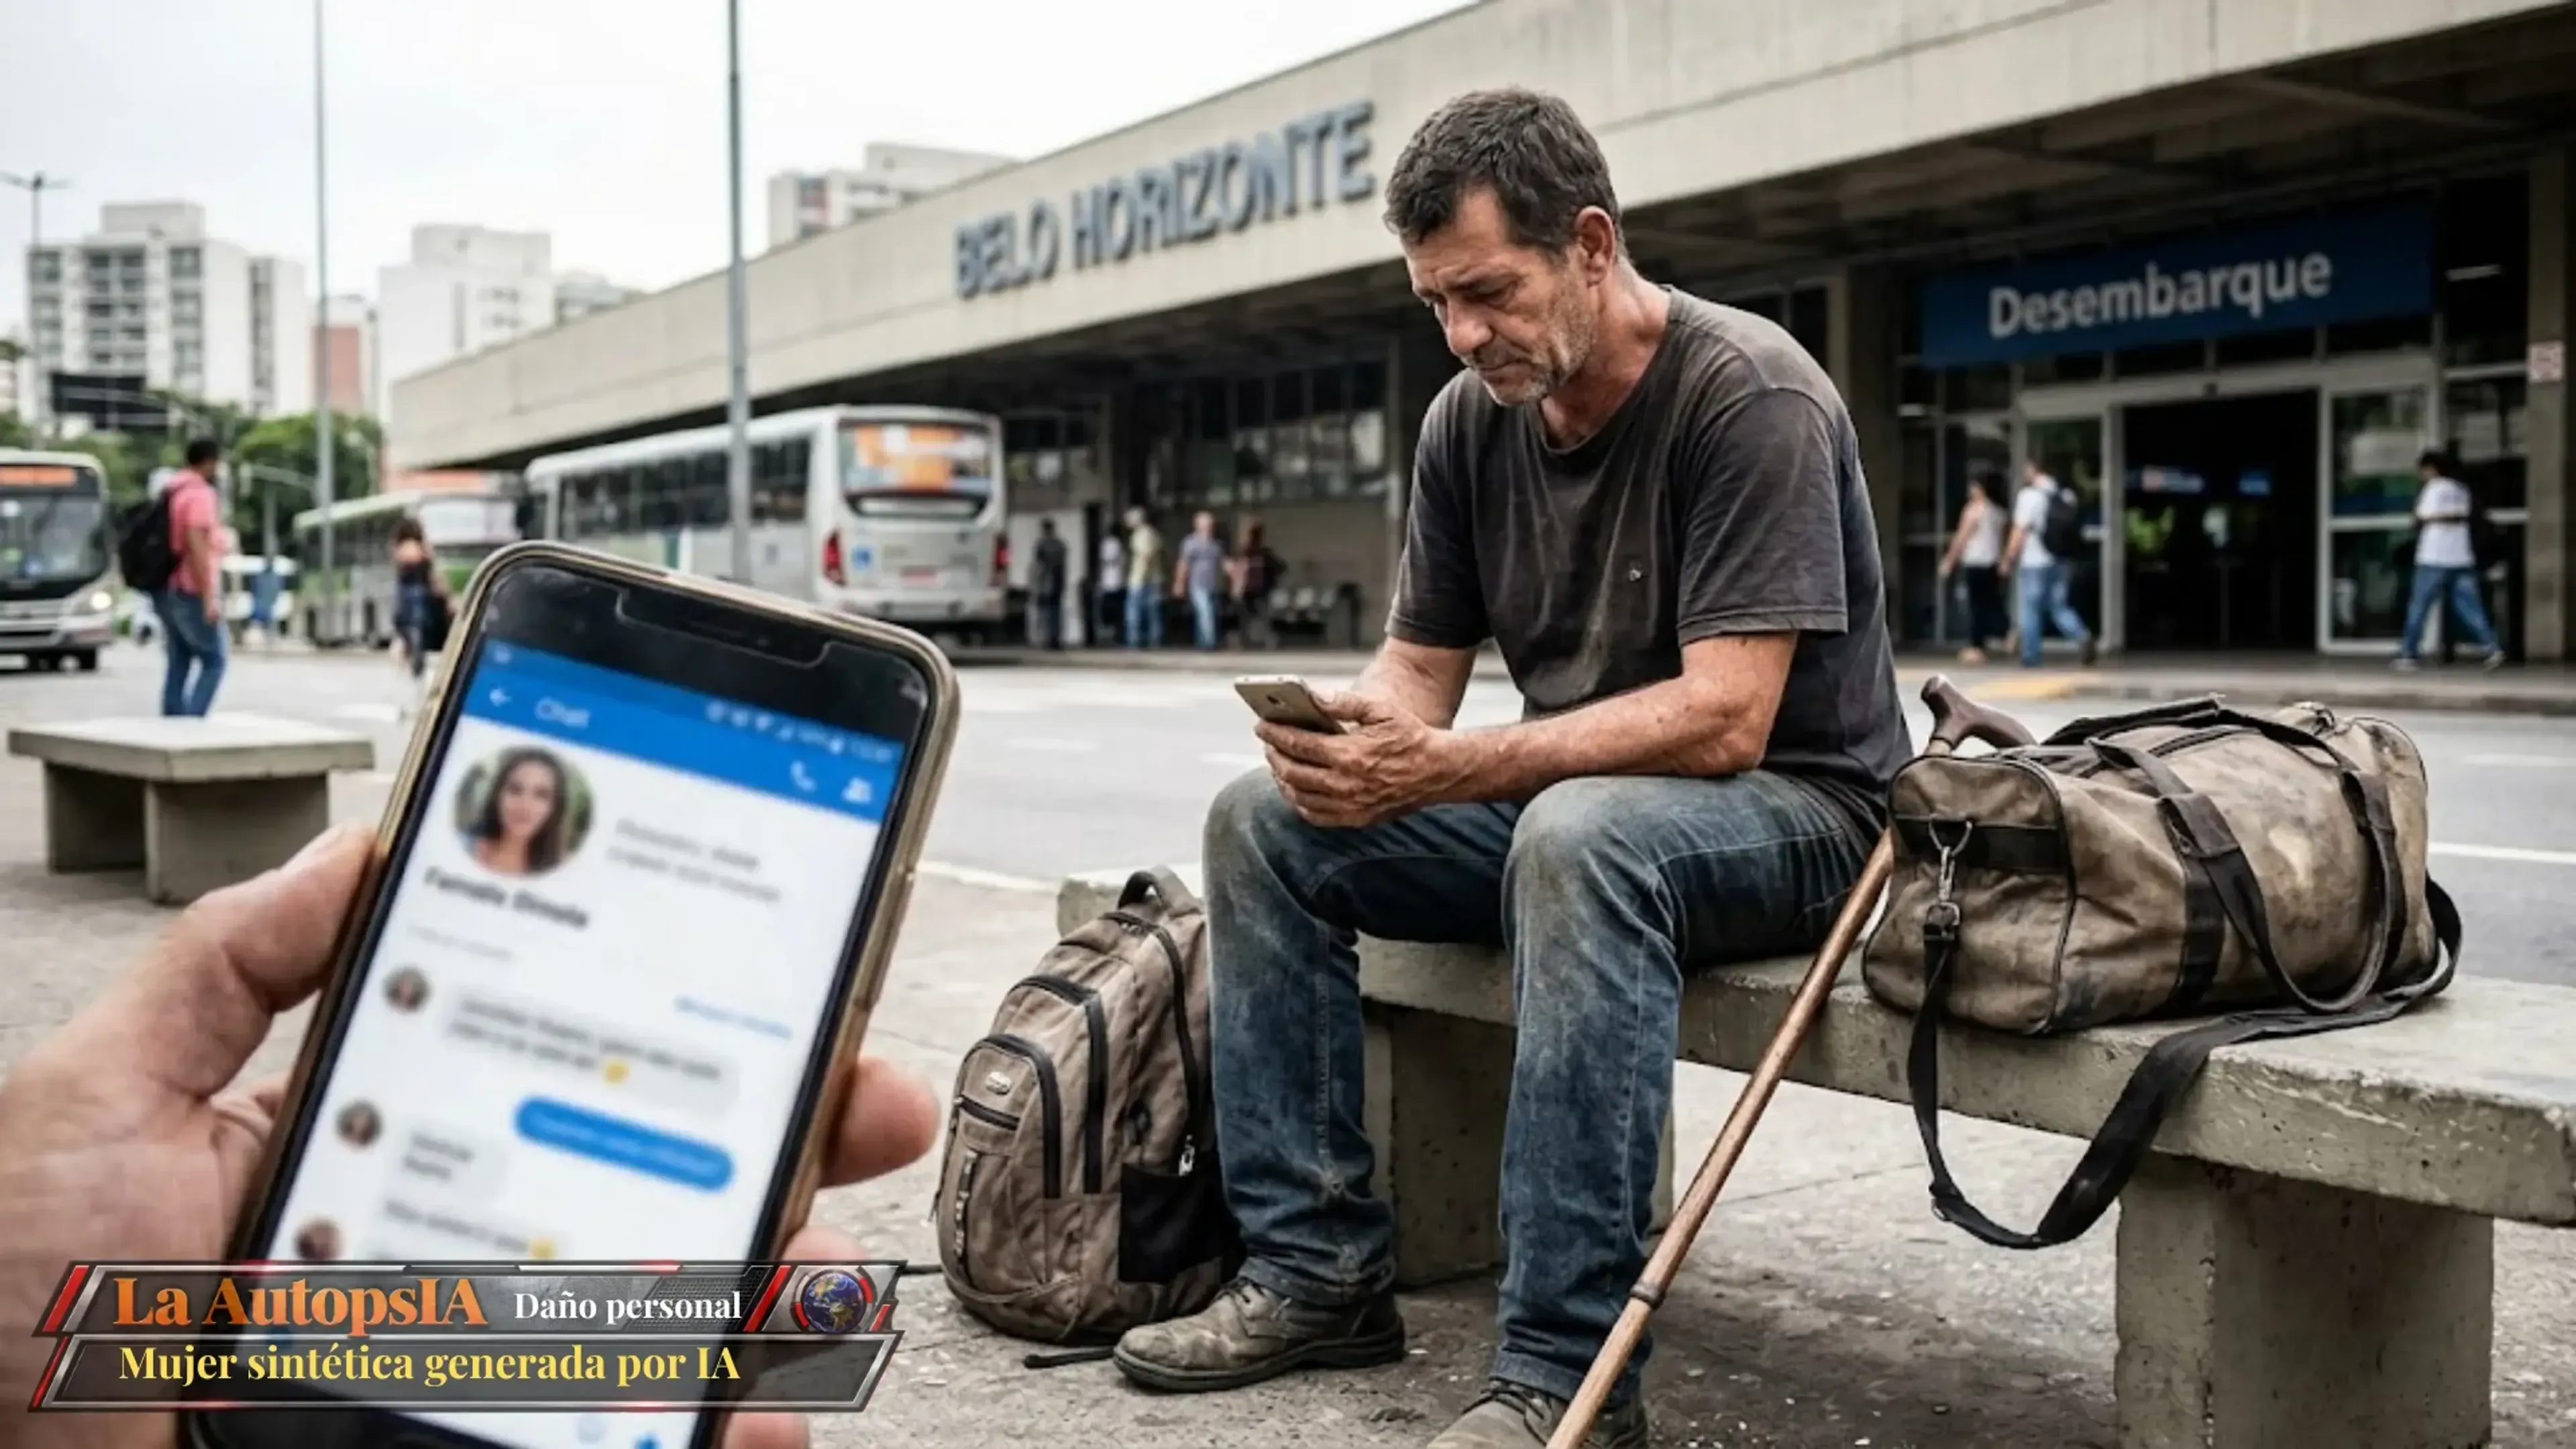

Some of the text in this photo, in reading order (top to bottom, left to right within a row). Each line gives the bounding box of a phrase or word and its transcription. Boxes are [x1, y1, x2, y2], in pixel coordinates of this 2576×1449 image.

[953, 99, 1375, 299] BELO HORIZONTE
[1989, 252, 2332, 338] Desembarque
